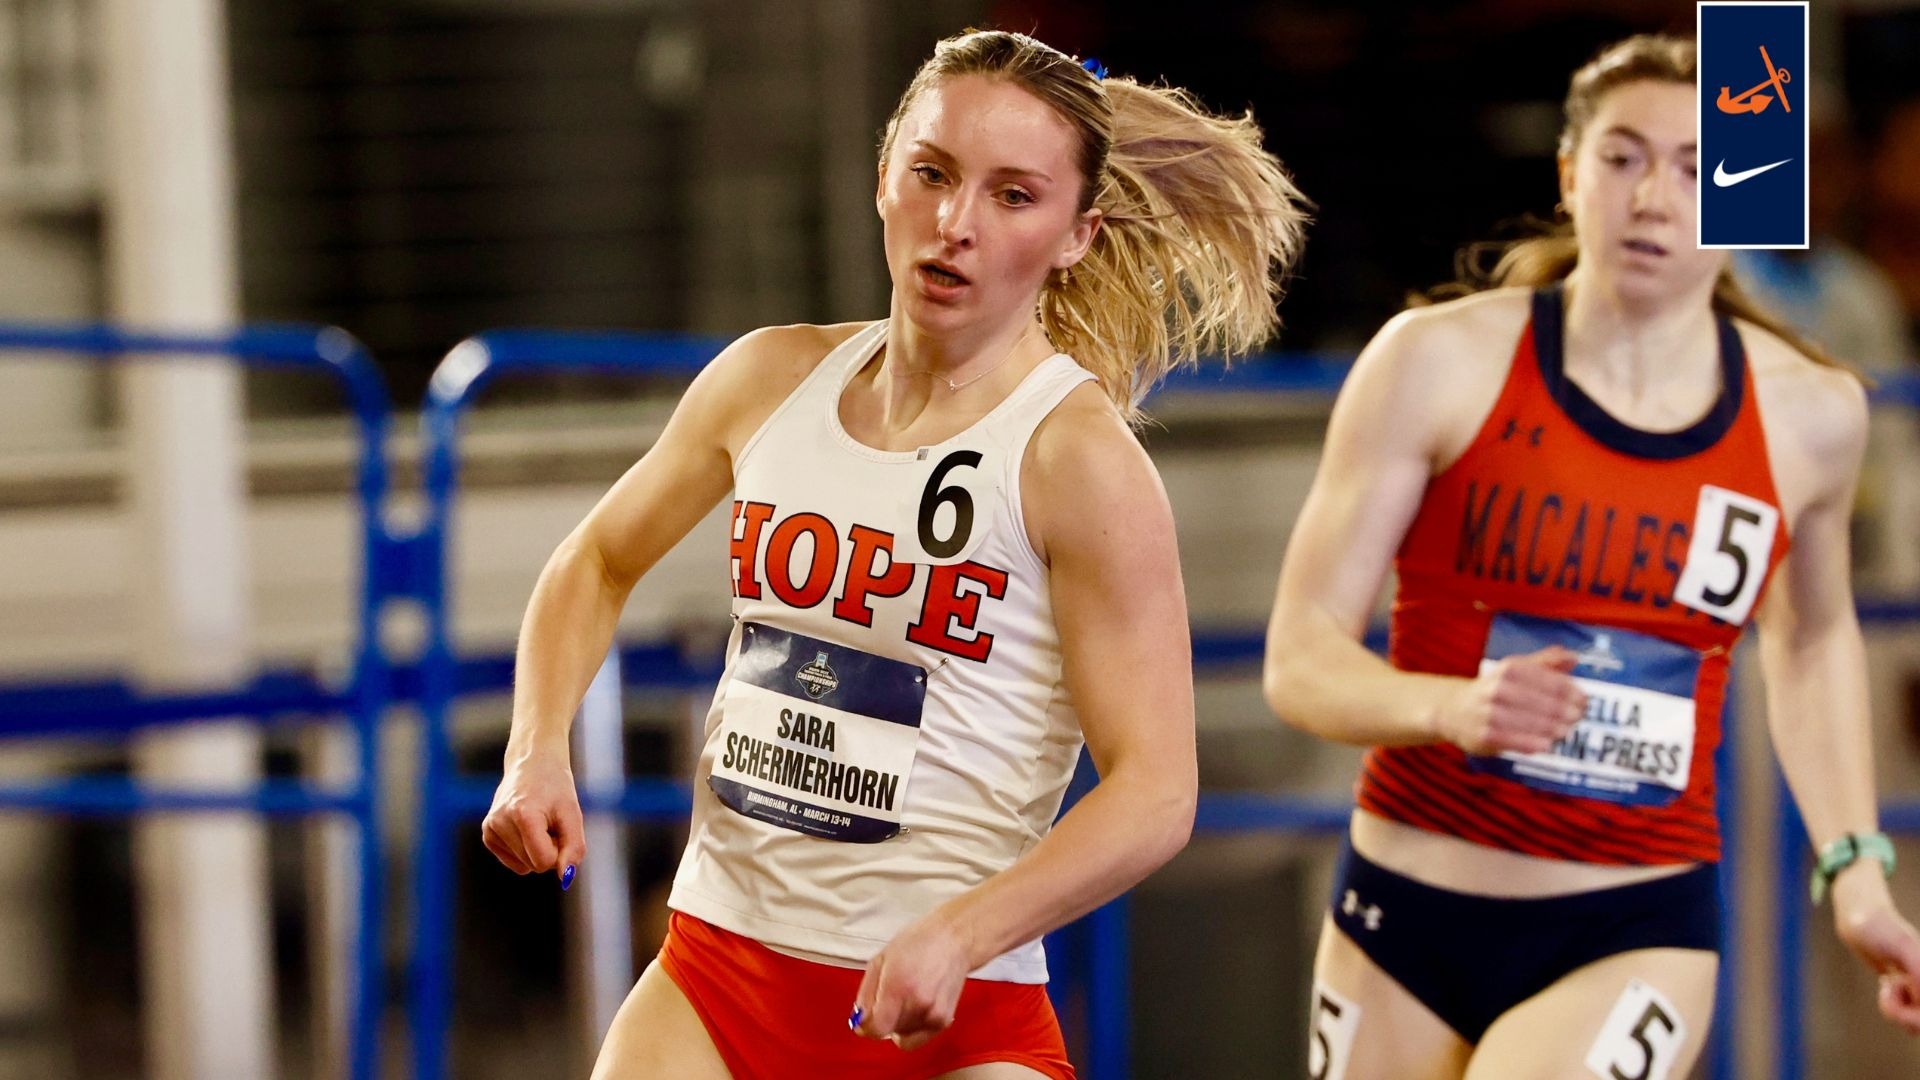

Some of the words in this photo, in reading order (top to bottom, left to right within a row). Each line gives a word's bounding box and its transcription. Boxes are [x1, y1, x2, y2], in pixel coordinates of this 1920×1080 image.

[917, 450, 983, 559] 6
[730, 500, 1009, 664] HOPE
[1454, 480, 1727, 625] MACALES
[1702, 504, 1761, 608] 5
[722, 731, 900, 812] SCHERMERHORN
[777, 708, 836, 752] SARA
[746, 791, 788, 813] BIRMINGHAM,
[789, 805, 799, 815] AL
[803, 808, 830, 823] MARCH
[830, 815, 852, 827] 13-14
[1609, 1000, 1675, 1080] 5
